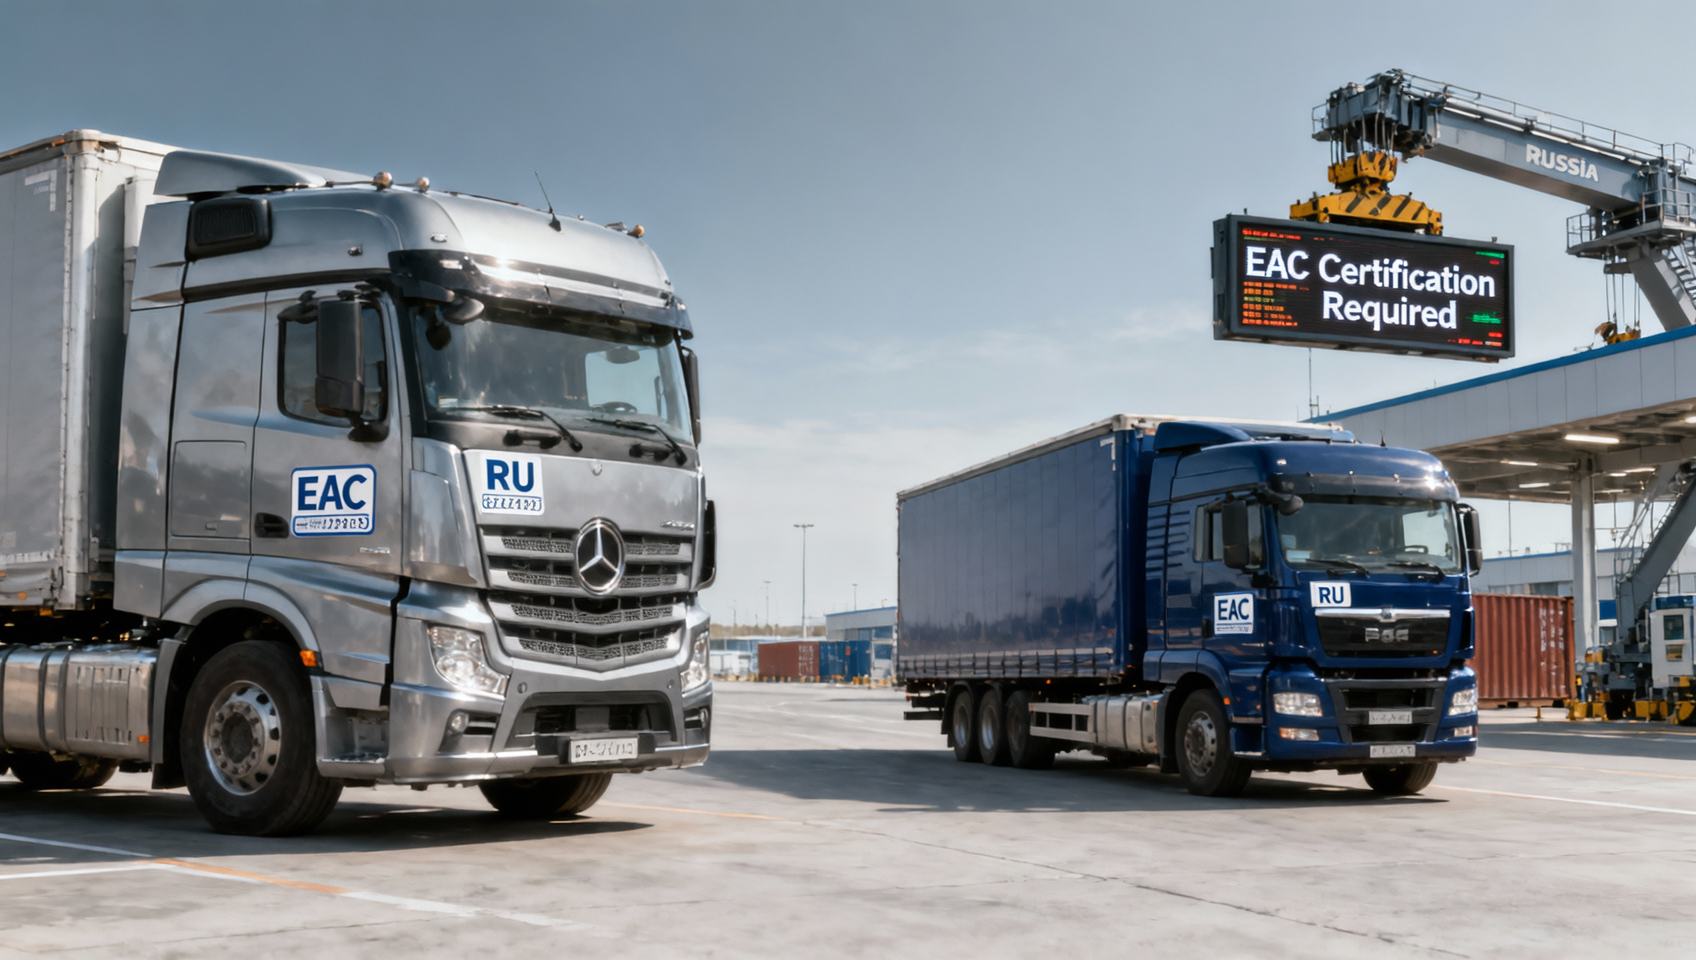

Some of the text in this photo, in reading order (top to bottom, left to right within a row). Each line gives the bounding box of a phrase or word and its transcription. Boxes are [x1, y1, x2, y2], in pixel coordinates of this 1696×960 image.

[1525, 143, 1599, 182] RUSSIA
[1246, 245, 1495, 297] EAC Certification
[1322, 290, 1457, 331] Required
[297, 474, 367, 511] EAC
[486, 459, 534, 492] RU
[1218, 598, 1249, 620] EAC
[1318, 586, 1344, 604] RU
